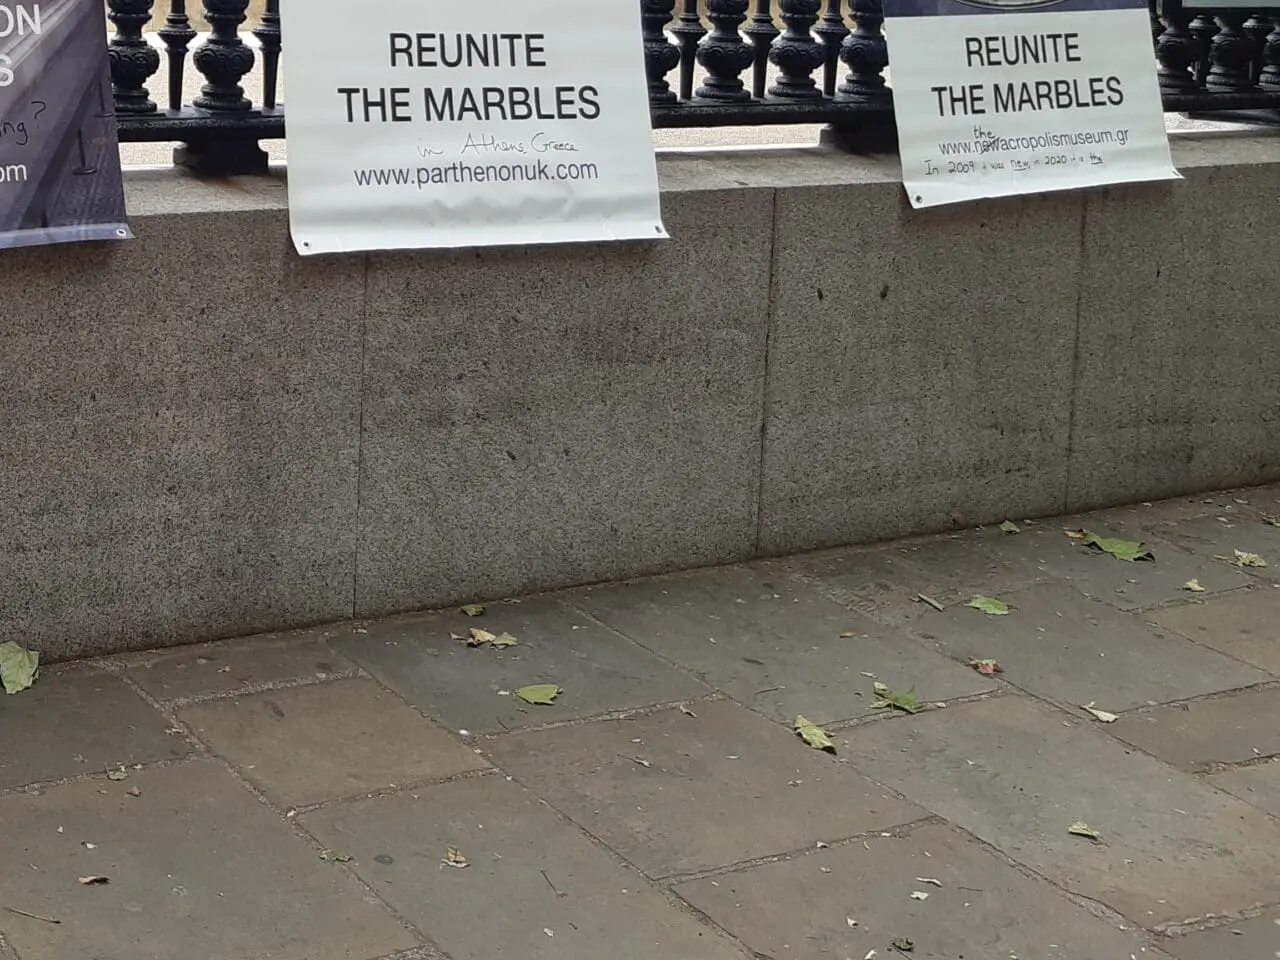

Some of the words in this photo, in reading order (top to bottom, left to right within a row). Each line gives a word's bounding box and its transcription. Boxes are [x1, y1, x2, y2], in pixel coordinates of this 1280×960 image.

[389, 32, 546, 68] REUNITE
[964, 32, 1081, 68] REUNITE
[337, 87, 412, 123] THE
[424, 85, 601, 122] MARBLES
[931, 84, 986, 117] THE
[993, 76, 1124, 114] MARBLES
[417, 137, 444, 158] in
[530, 131, 579, 153] Greece
[973, 124, 996, 139] the
[353, 159, 599, 189] www.parthenonuk.com
[924, 159, 939, 176] In
[947, 159, 976, 174] 2009
[1044, 154, 1067, 166] 2020
